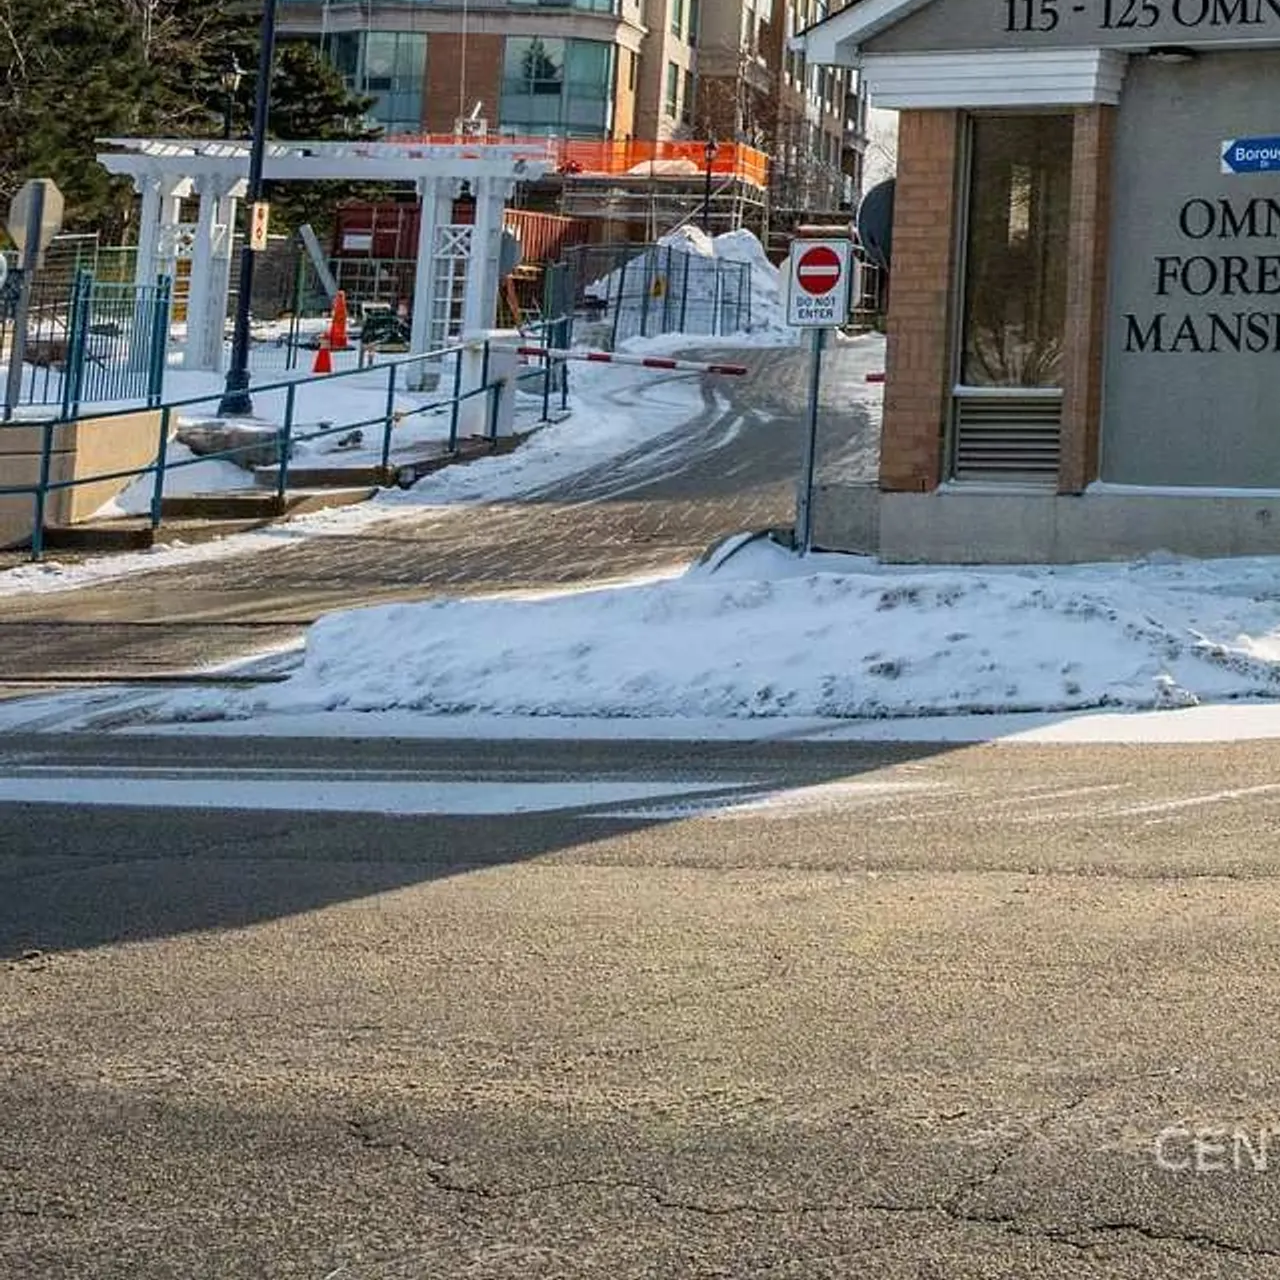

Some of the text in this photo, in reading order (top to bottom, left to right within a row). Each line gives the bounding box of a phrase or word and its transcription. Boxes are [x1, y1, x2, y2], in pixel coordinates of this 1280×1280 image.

[796, 296, 836, 307] DO NOT
[798, 308, 834, 319] ENTER
